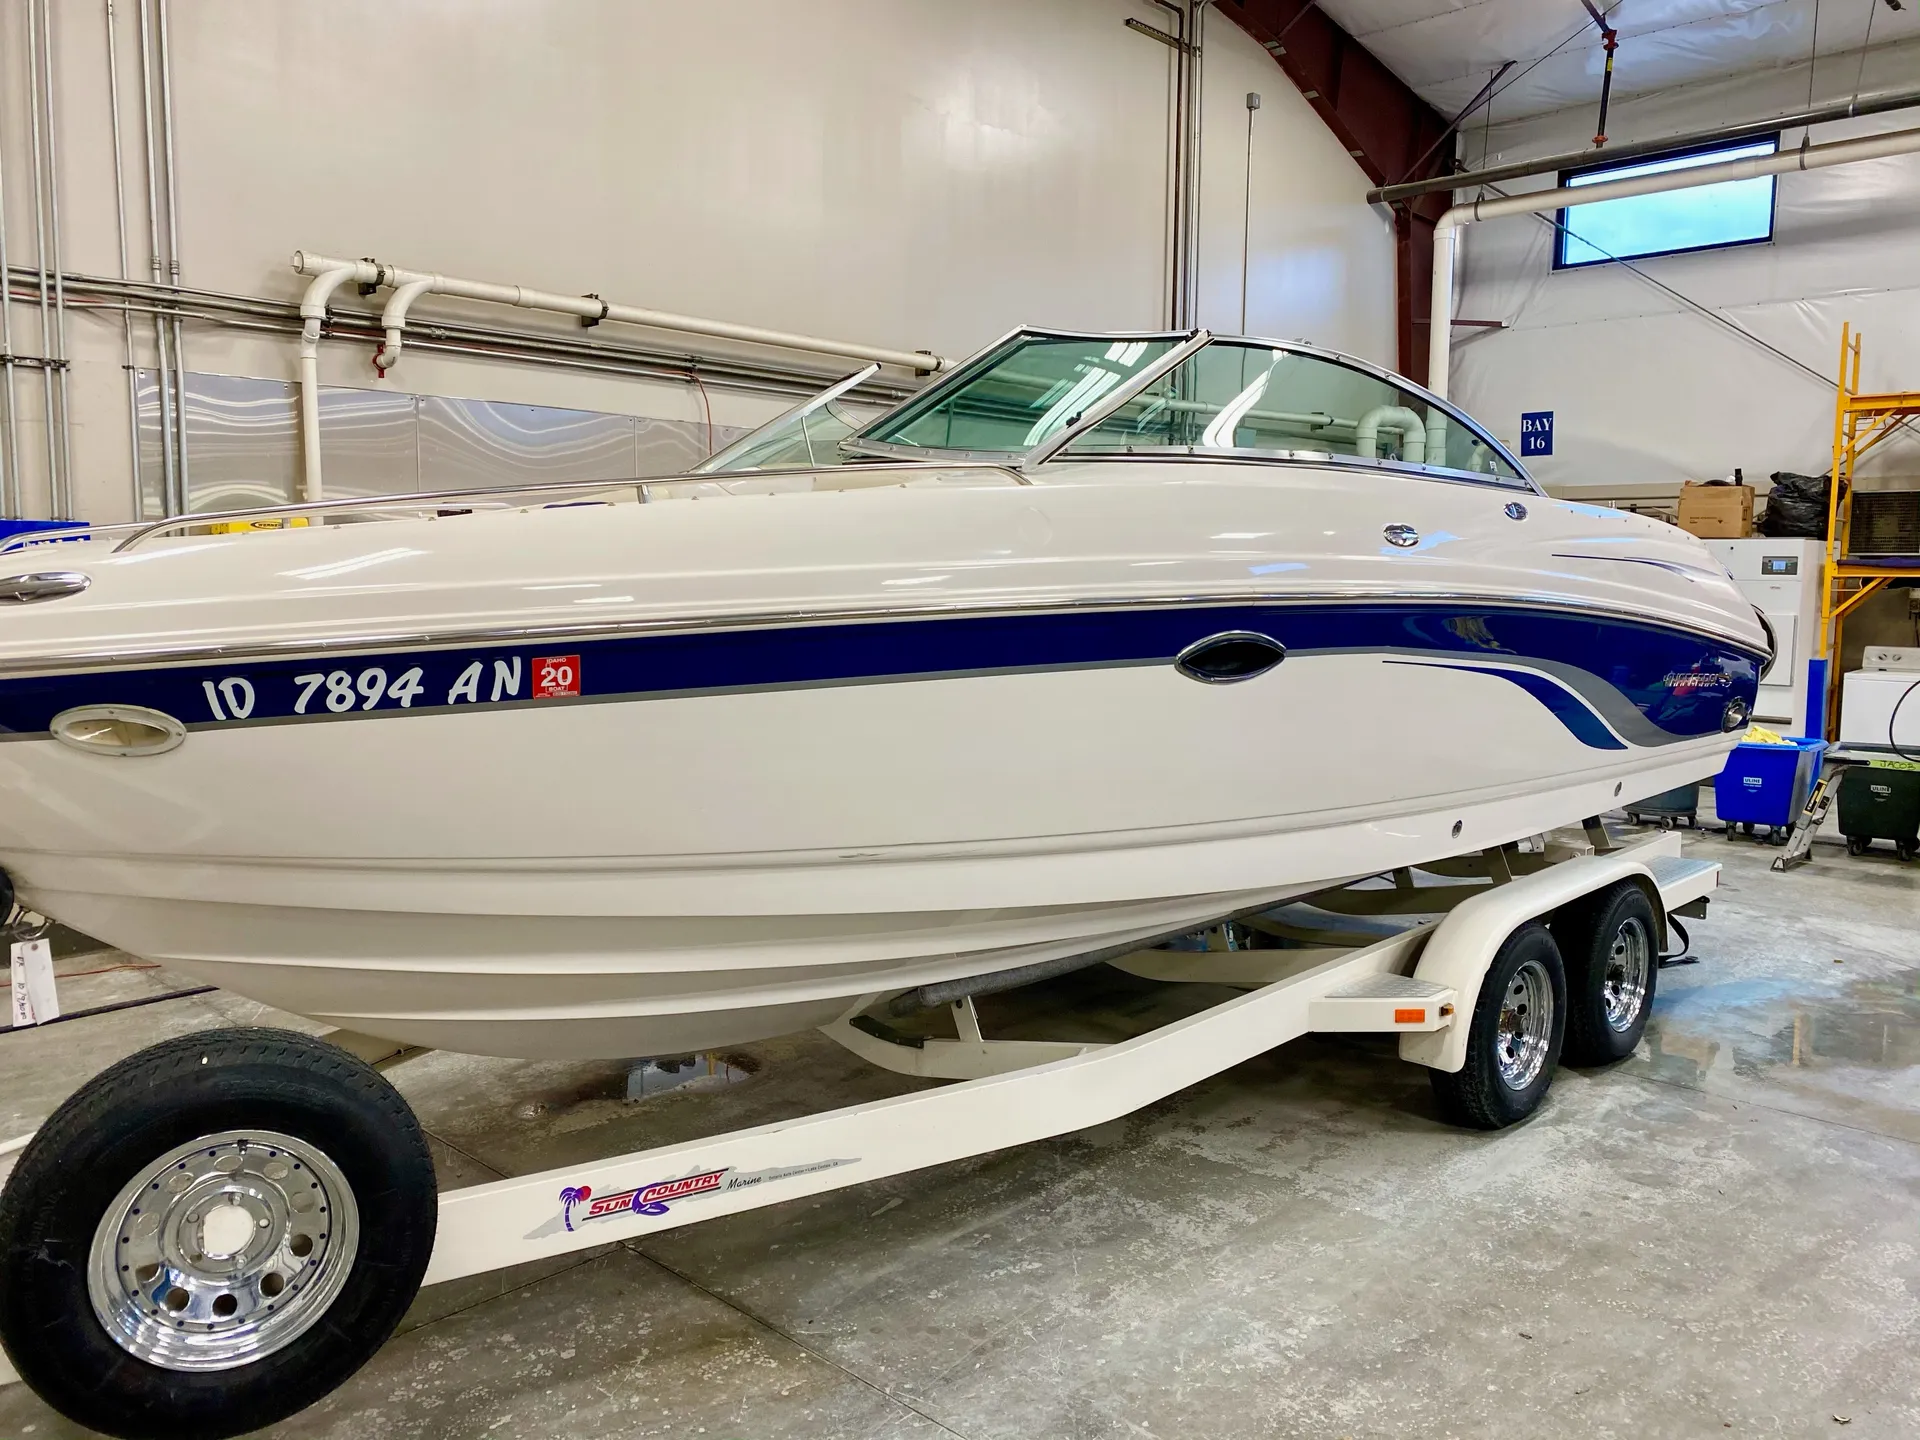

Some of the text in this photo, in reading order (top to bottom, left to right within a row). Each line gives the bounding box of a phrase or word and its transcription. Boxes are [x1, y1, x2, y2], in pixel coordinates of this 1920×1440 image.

[1522, 418, 1552, 433] BAY
[1528, 436, 1545, 449] 16
[540, 665, 573, 687] 20
[202, 656, 522, 721] ID 7894 AN
[589, 1198, 632, 1216] SUN
[641, 1172, 725, 1204] COUNTRY
[727, 1176, 762, 1190] Marine
